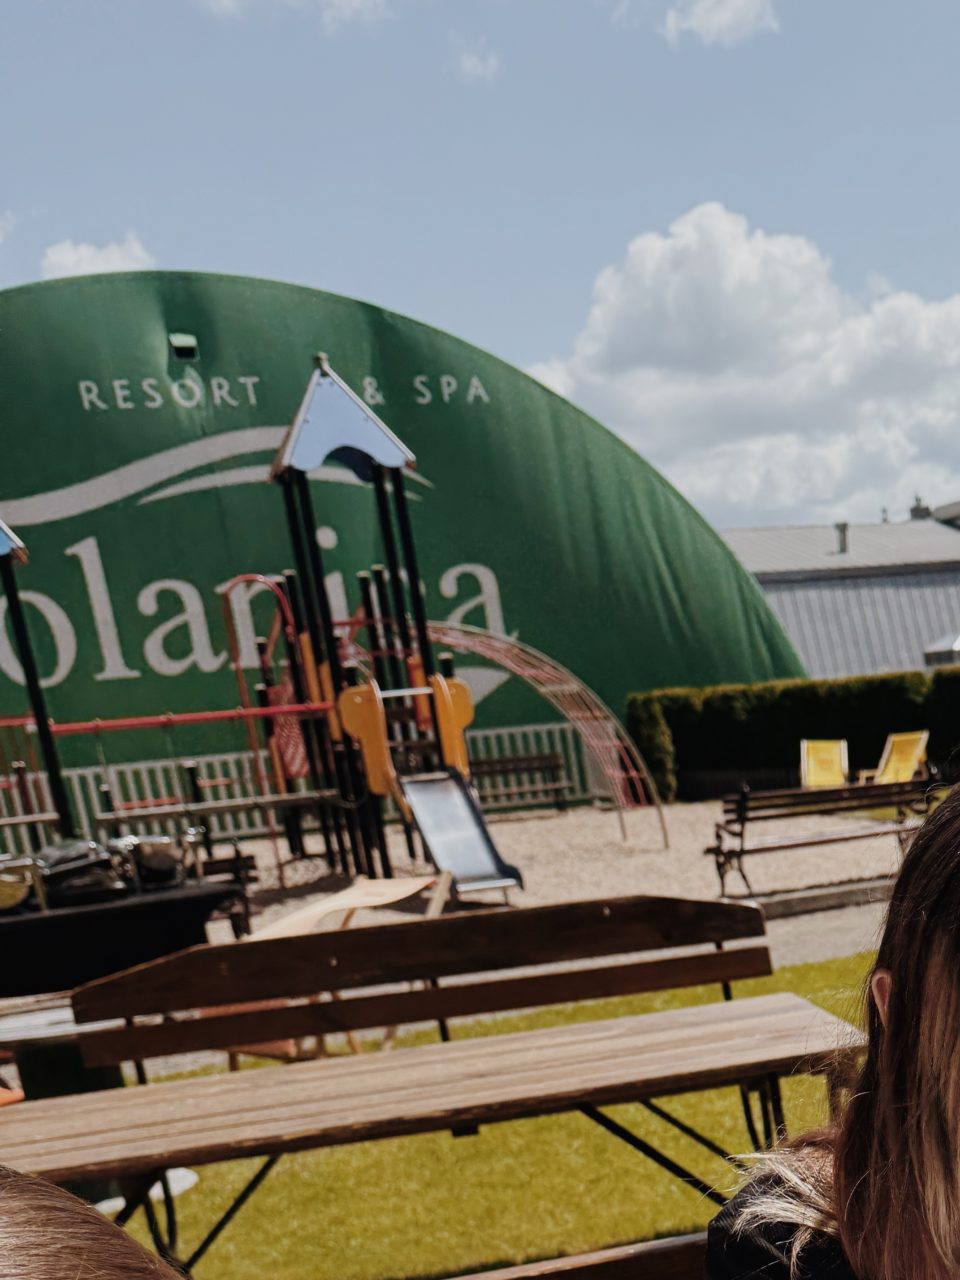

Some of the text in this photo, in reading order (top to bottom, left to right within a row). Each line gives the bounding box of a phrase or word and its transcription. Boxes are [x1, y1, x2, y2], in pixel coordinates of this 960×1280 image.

[80, 375, 491, 411] RESORT & SPA
[0, 526, 519, 688] olania
